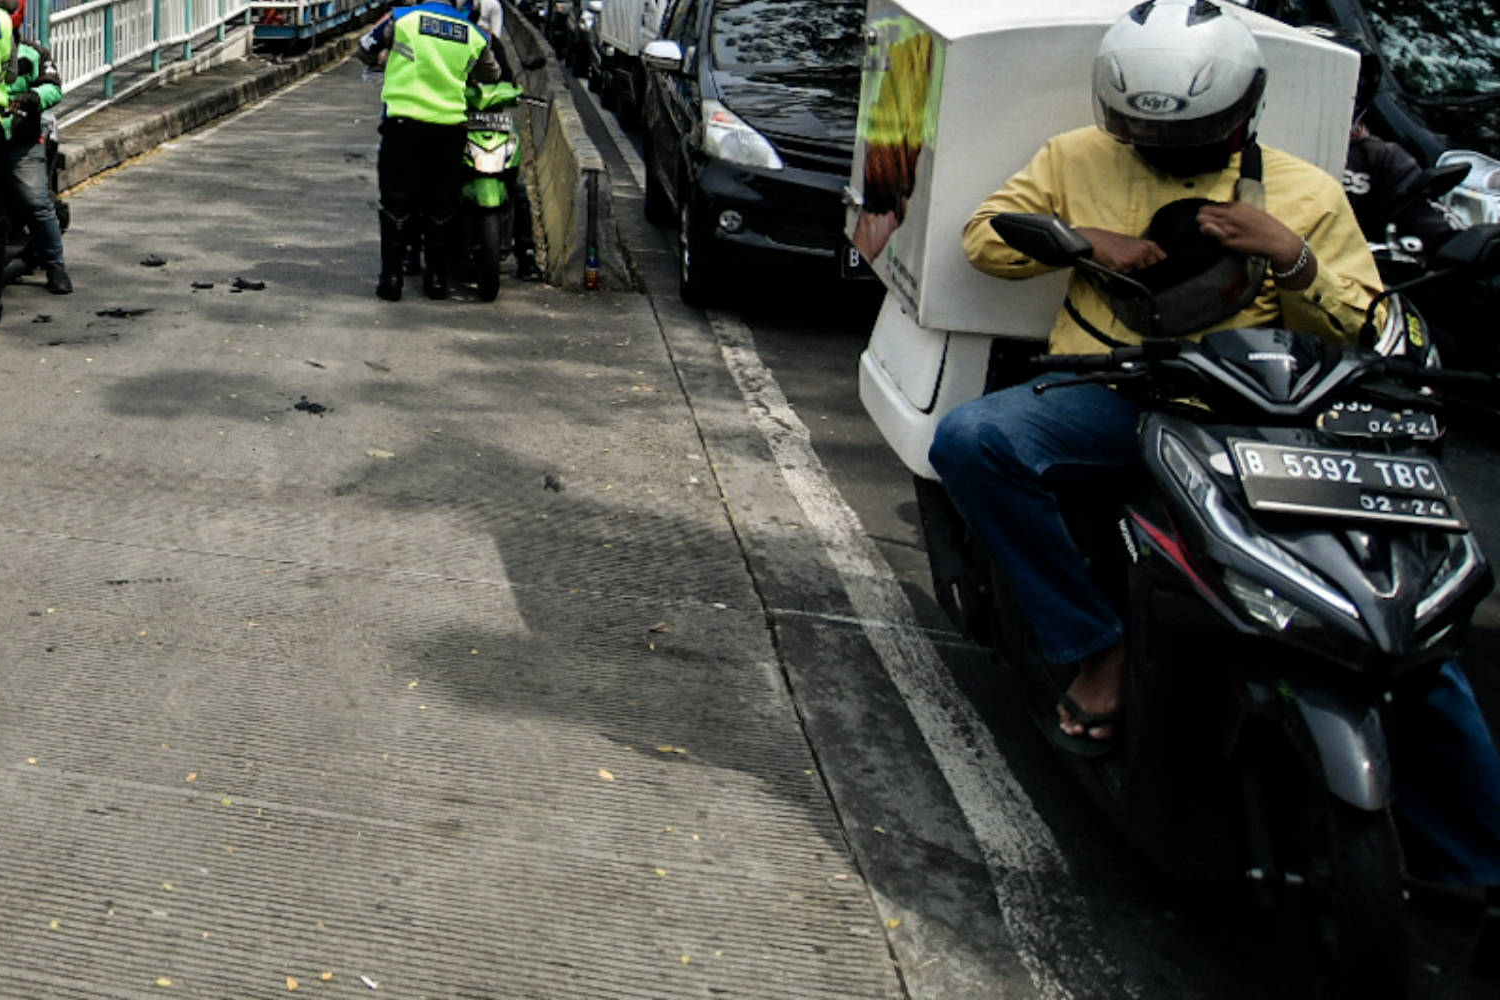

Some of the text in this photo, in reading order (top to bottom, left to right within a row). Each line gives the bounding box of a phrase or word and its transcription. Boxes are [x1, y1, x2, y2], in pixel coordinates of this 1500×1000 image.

[422, 16, 467, 41] POLISI
[849, 247, 860, 267] B
[1245, 449, 1436, 491] B 5392 TBC
